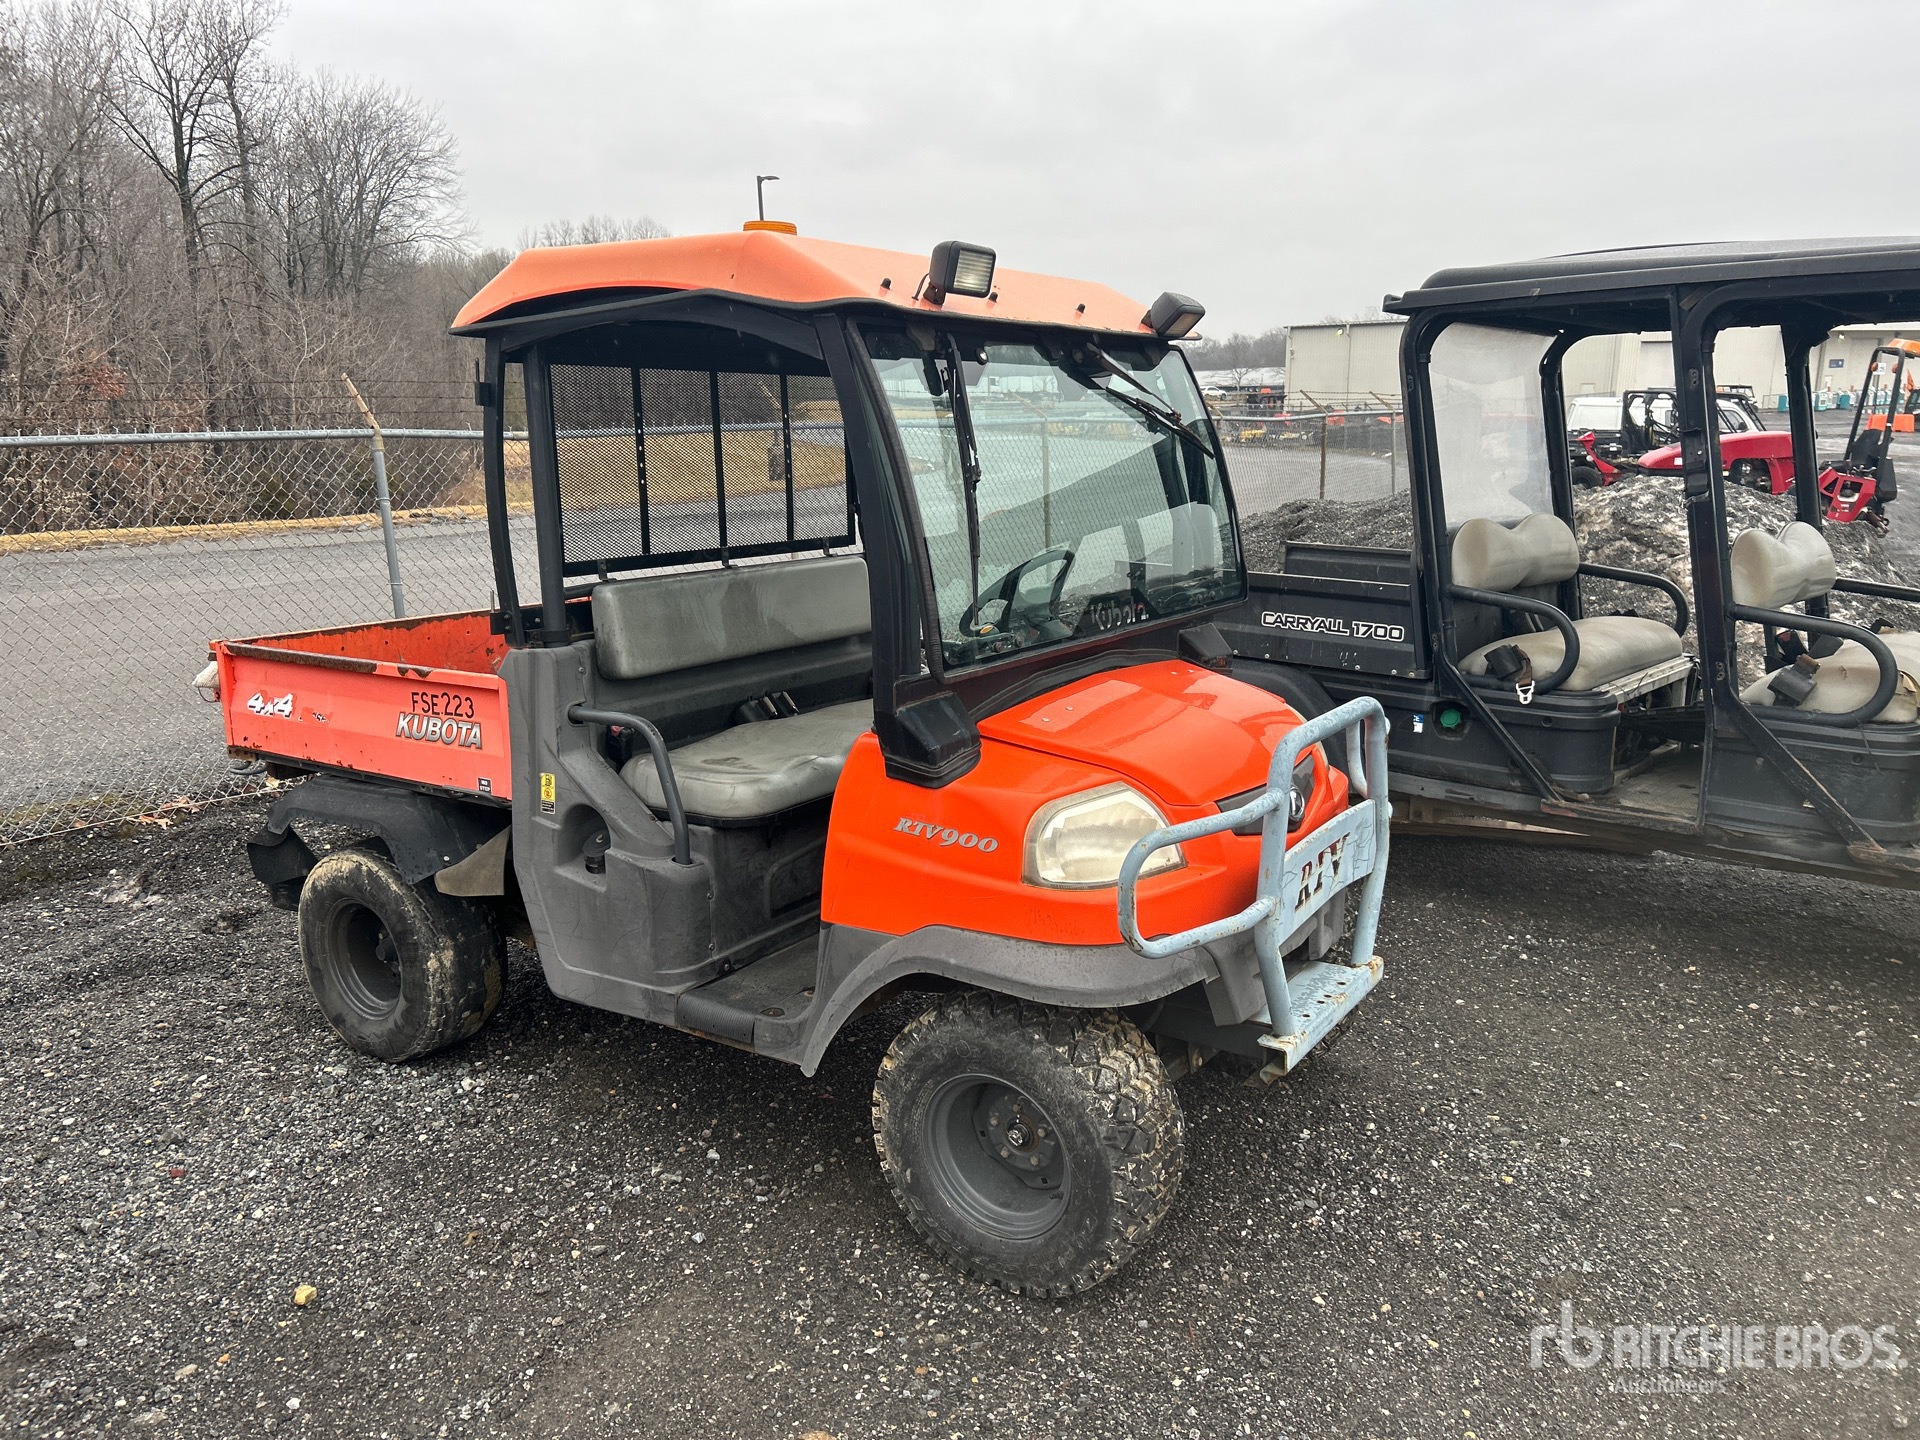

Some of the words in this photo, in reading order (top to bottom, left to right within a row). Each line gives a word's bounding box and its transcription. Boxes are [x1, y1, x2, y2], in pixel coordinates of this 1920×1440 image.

[1261, 611, 1350, 636] CARRYALL
[1352, 620, 1405, 642] 1700
[395, 711, 482, 750] KUBOTA
[893, 816, 999, 852] RTV900
